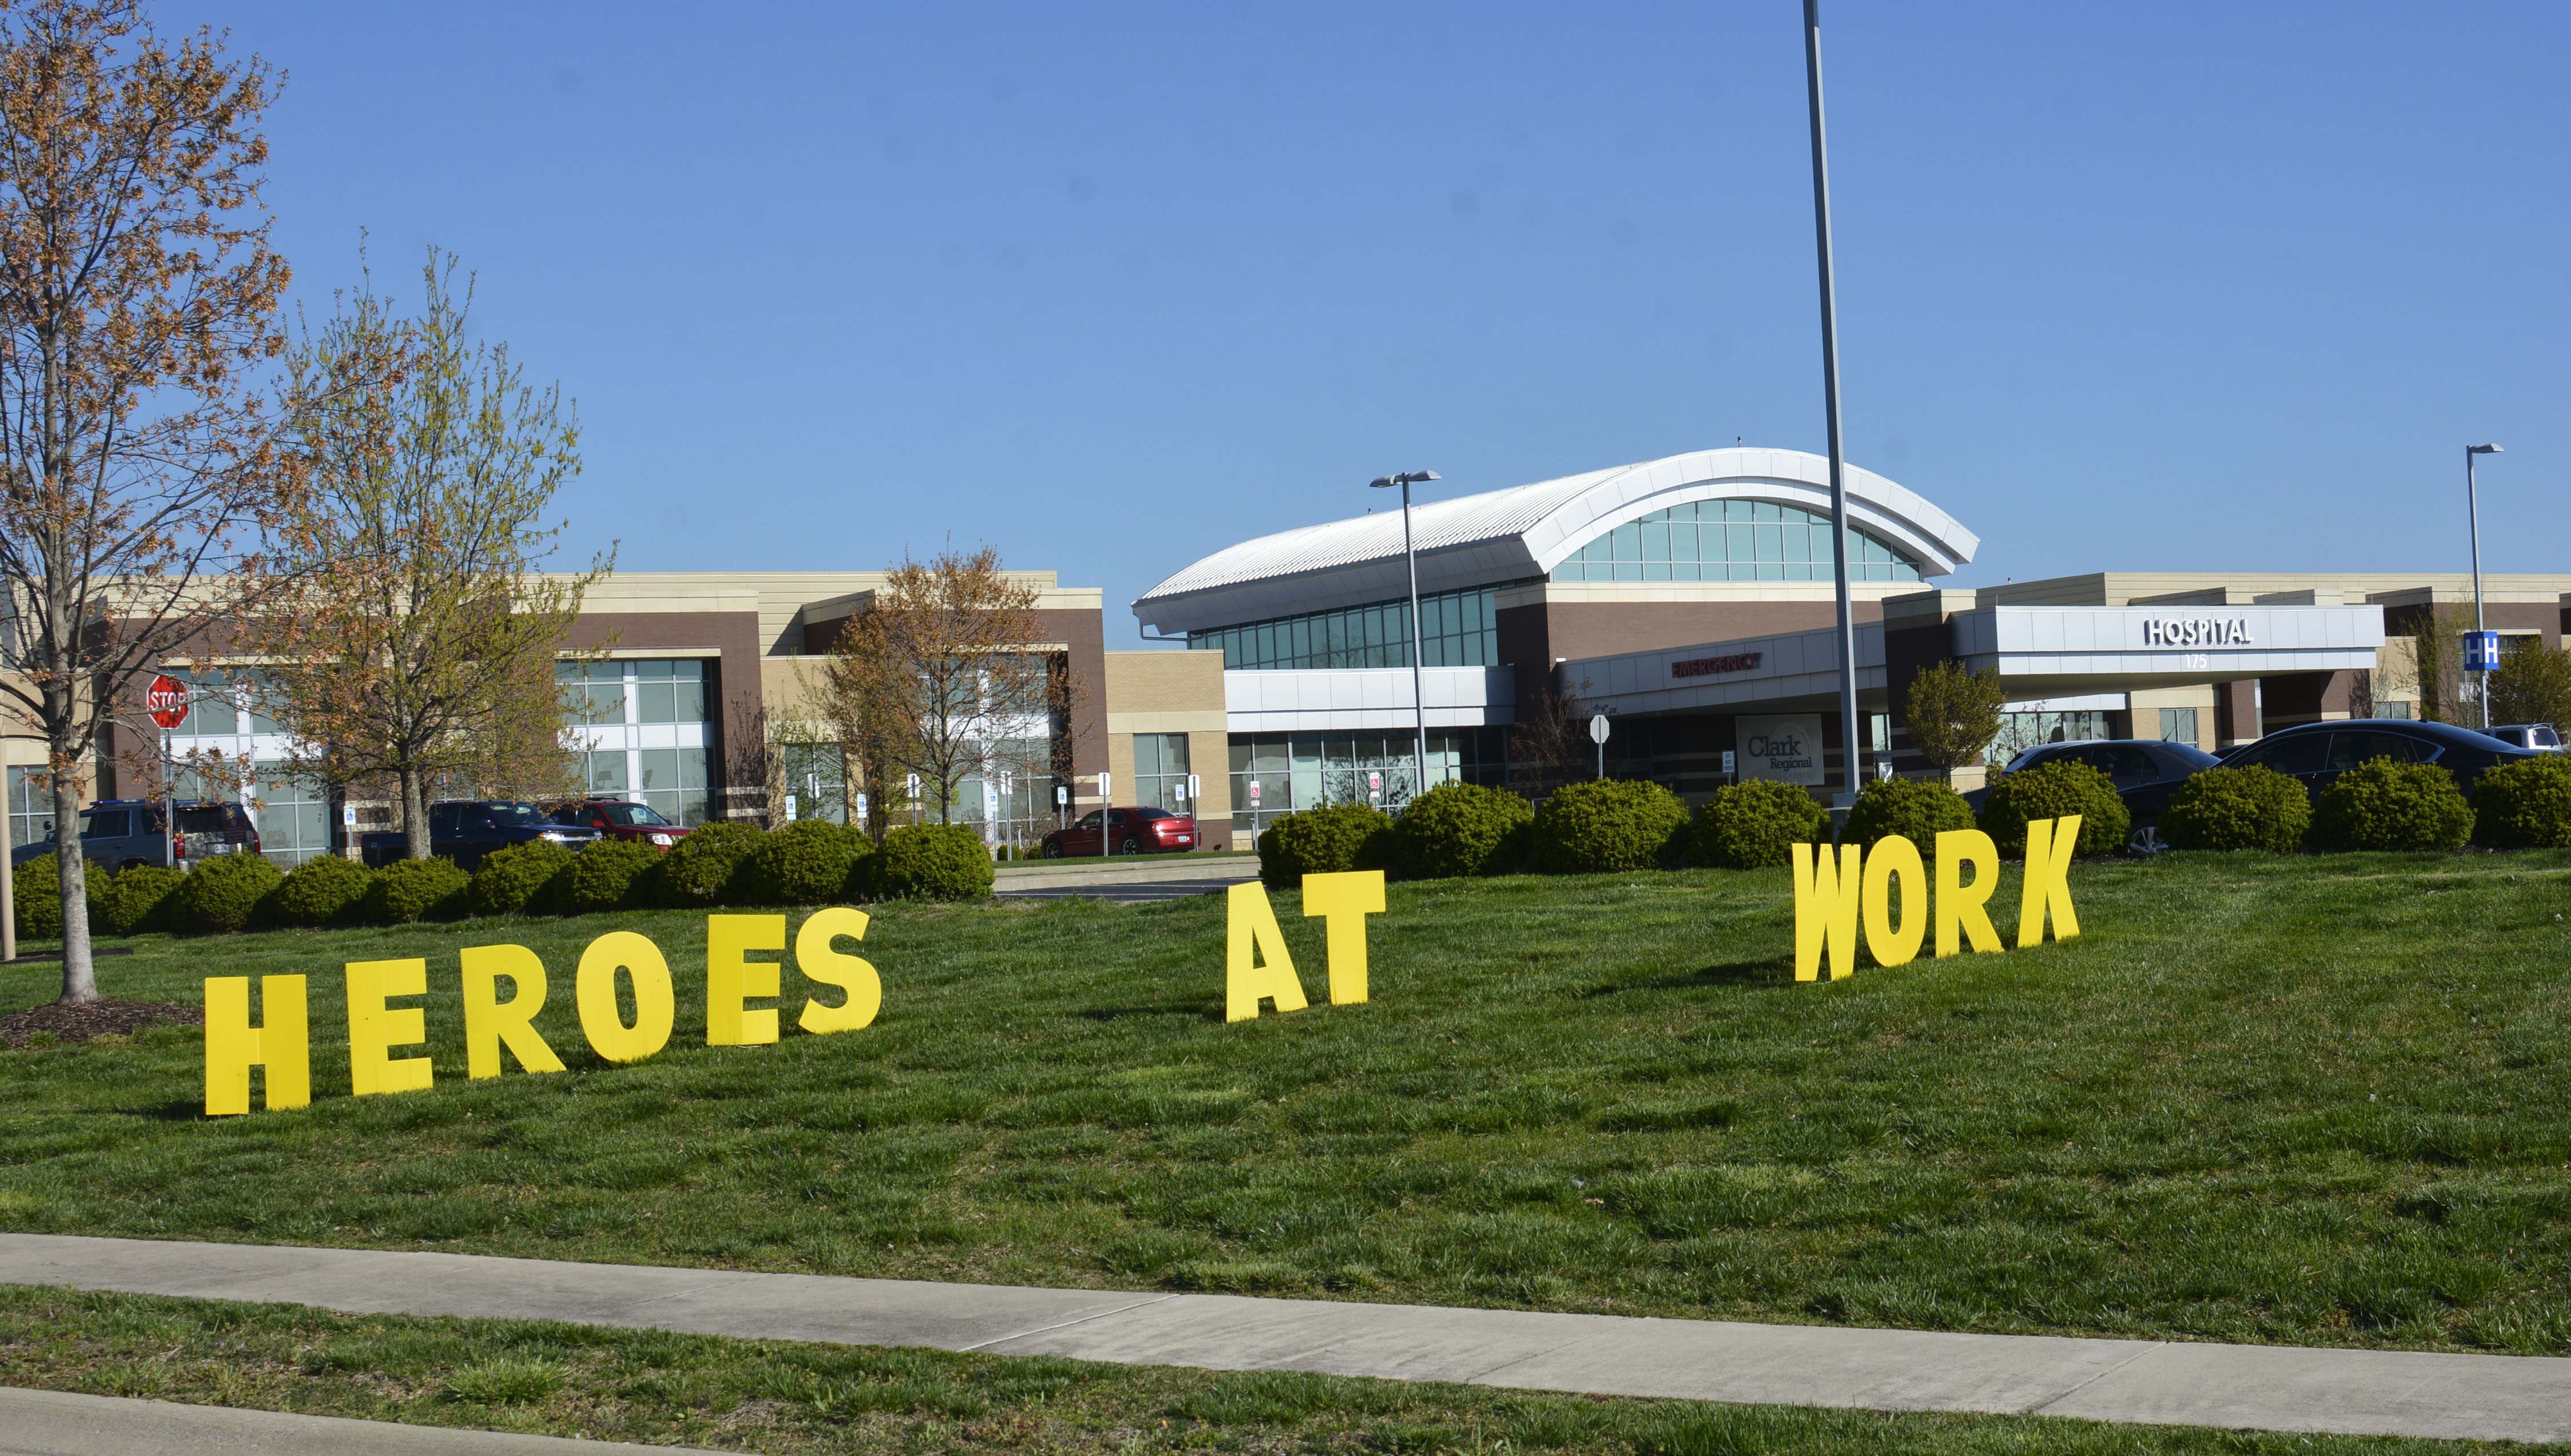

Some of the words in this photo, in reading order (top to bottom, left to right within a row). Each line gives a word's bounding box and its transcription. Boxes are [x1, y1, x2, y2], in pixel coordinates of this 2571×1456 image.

[2144, 618, 2254, 644] HOSPITAL
[2184, 654, 2207, 669] 175
[2465, 638, 2483, 664] H
[2485, 637, 2498, 663] H
[1671, 652, 1758, 678] EMERGENCY
[150, 691, 186, 712] STOP
[1748, 735, 1801, 757] Clark
[1770, 756, 1812, 772] Regional
[204, 908, 882, 1116] HEROES
[1226, 870, 1386, 1022] AT
[1792, 815, 2082, 982] WORK
